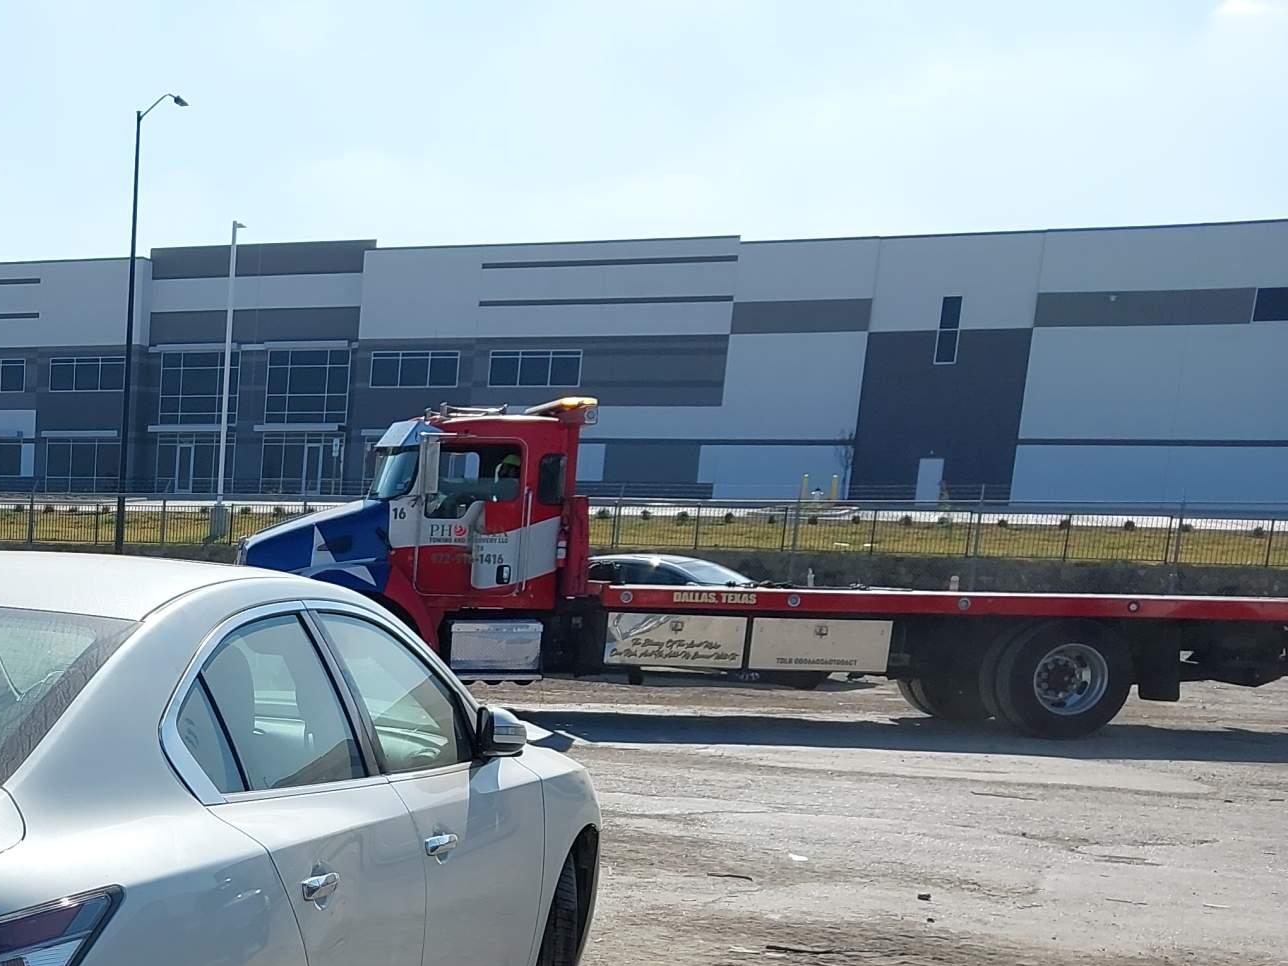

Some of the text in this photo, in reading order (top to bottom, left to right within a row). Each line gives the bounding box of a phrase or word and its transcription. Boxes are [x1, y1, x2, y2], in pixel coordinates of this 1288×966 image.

[392, 507, 407, 520] 16
[673, 592, 758, 605] DALLAS, TEXAS
